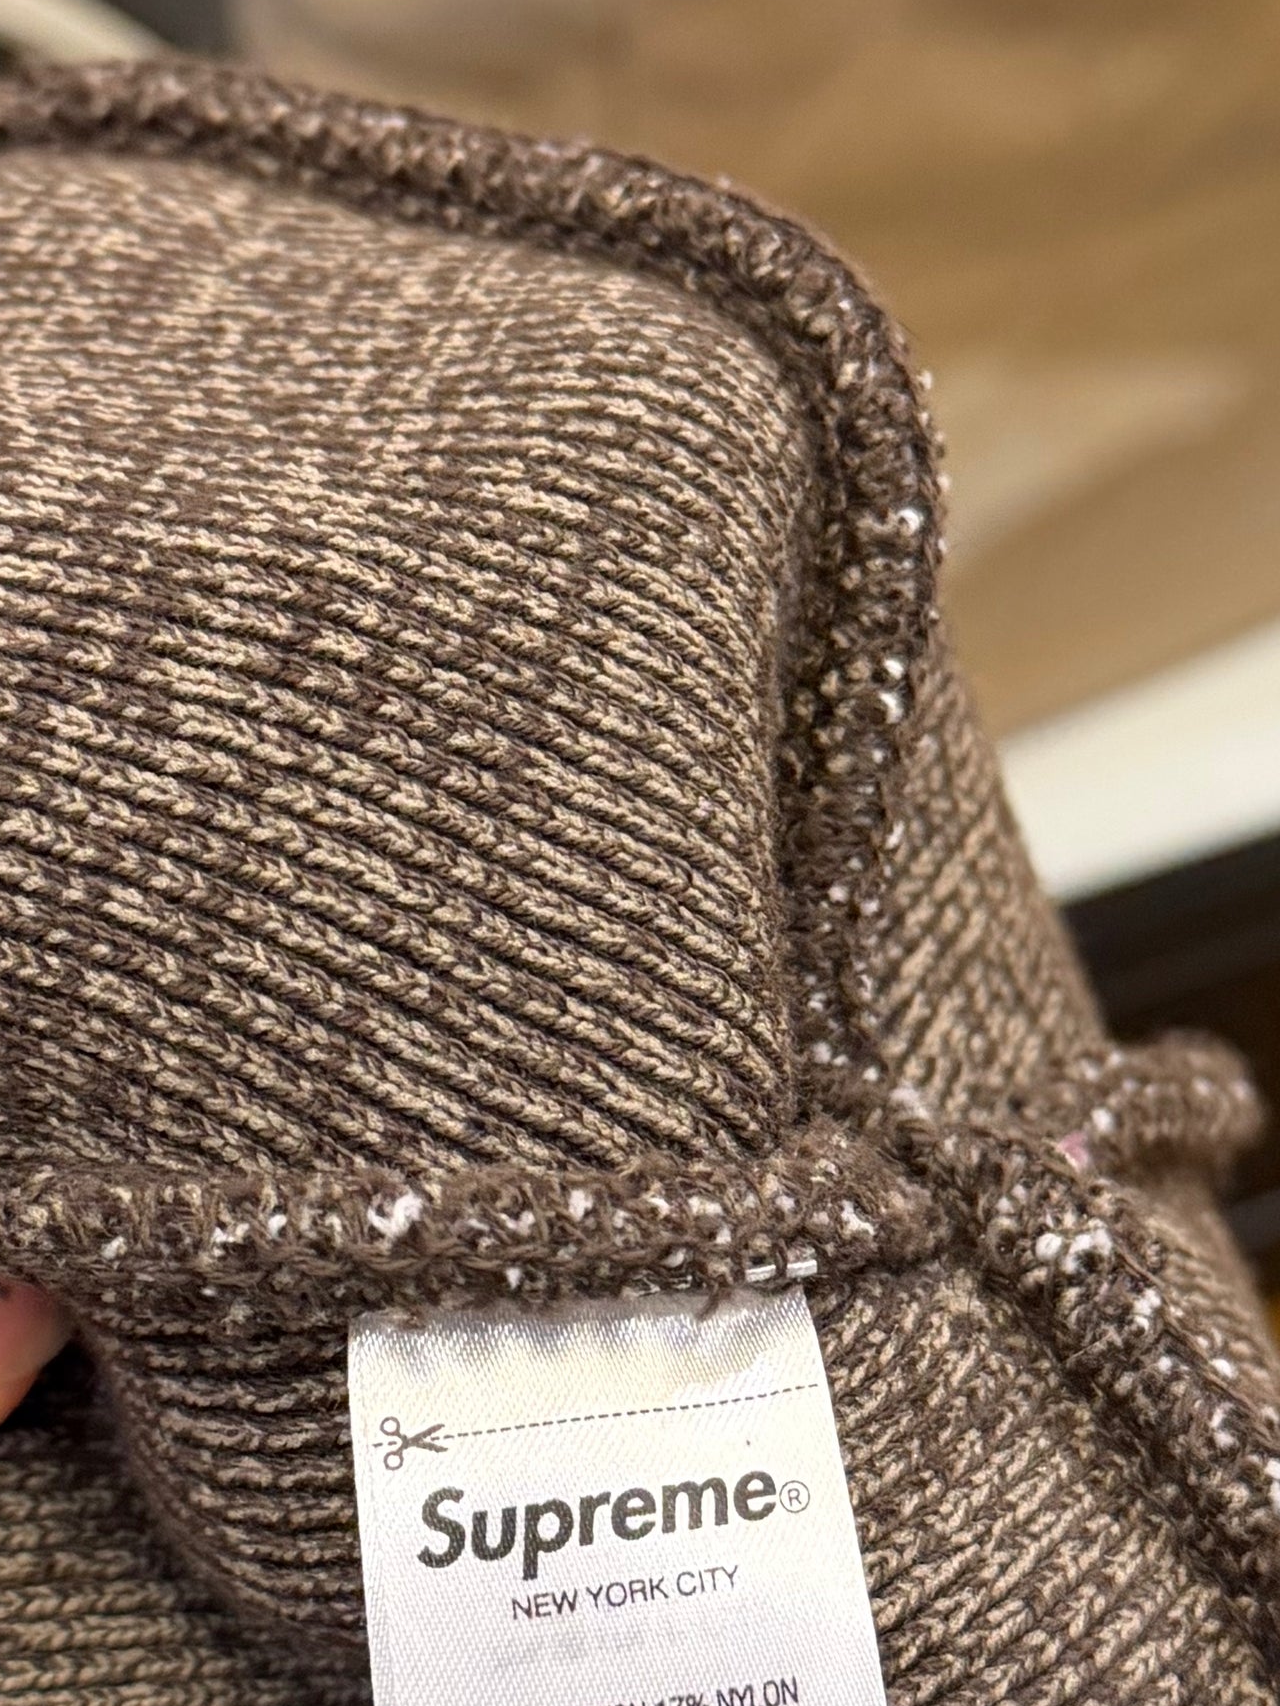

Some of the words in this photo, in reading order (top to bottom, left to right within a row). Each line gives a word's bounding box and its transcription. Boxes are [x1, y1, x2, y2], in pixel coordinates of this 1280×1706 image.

[511, 1588, 578, 1620] NEW
[586, 1576, 666, 1608] YORK
[675, 1565, 739, 1596] CITY
